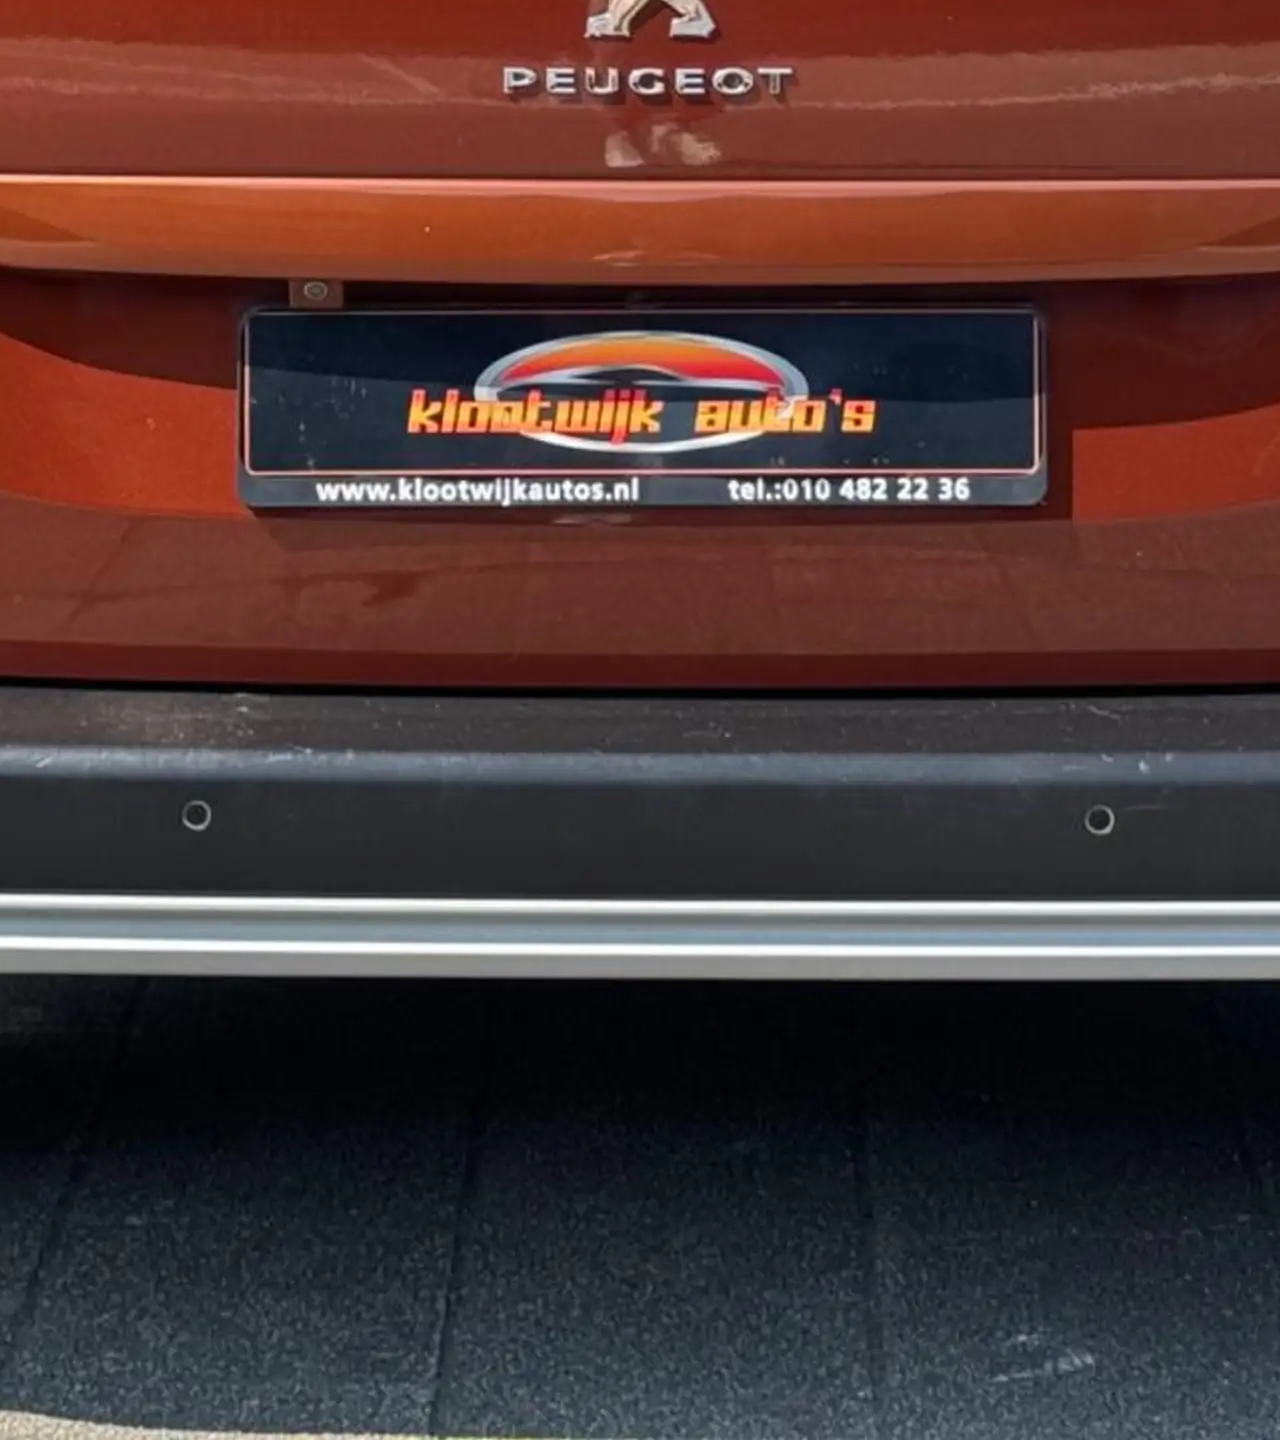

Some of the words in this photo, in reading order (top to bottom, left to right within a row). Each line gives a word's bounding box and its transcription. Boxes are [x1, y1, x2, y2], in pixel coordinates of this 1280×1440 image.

[502, 66, 794, 96] PEUGEOT
[407, 389, 664, 445] klootwijk
[694, 387, 877, 434] auto's
[316, 477, 639, 506] www.klootwijkautos.nl
[727, 477, 832, 502] tel.:010
[838, 477, 889, 502] 482
[896, 477, 930, 502] 22
[937, 477, 971, 502] 36
